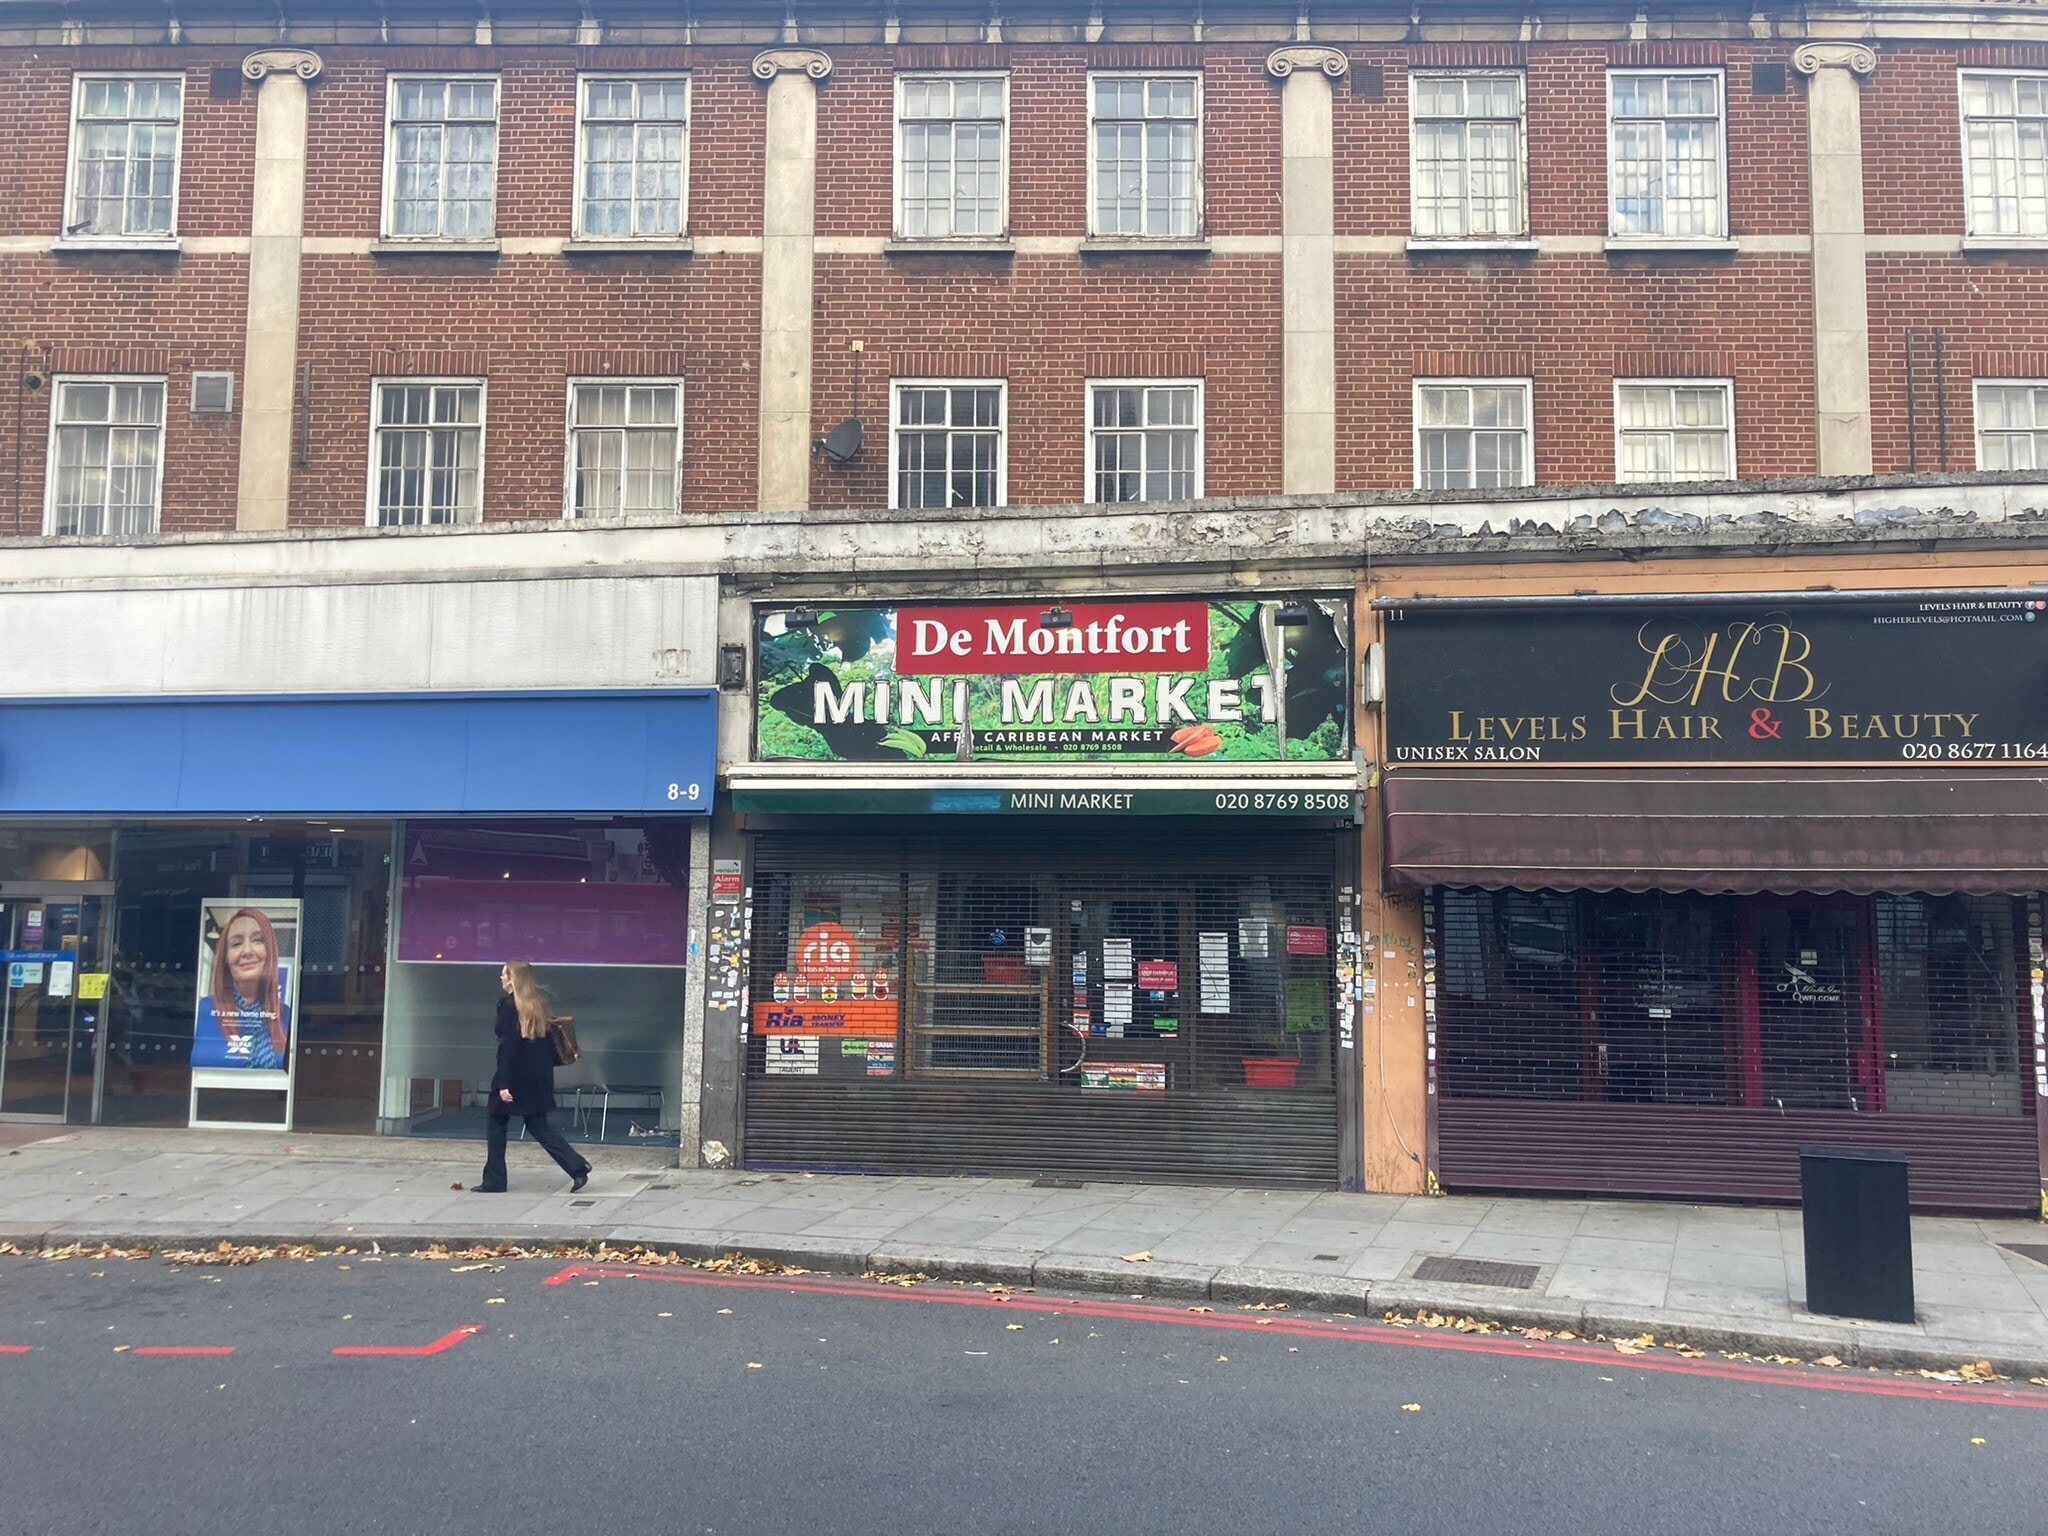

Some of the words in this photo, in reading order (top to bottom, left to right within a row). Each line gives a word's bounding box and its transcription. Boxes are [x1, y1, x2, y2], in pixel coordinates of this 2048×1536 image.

[1919, 603, 1950, 611] LEVELS
[1952, 602, 1977, 610] HAIR
[1986, 601, 2023, 609] BEAUTY
[1388, 609, 1405, 621] 11
[911, 619, 973, 656] De
[983, 614, 1191, 656] Montfort
[813, 677, 970, 725] MINI
[1001, 674, 1287, 725] MARKET
[1748, 706, 1782, 740] &
[931, 731, 975, 743] AFR
[984, 731, 1083, 743] CARIBBEAN
[1092, 731, 1164, 743] MARKET
[972, 743, 994, 752] etail
[995, 743, 1002, 751] &
[1004, 743, 1048, 751] Wholesale
[1063, 743, 1078, 751] 020
[1080, 743, 1100, 751] 8769
[1101, 743, 1123, 751] 8508
[1396, 747, 1469, 761] UNISEX
[1473, 747, 1541, 761] SALON
[1902, 742, 1942, 760] 020
[1948, 742, 1996, 760] 8677
[2001, 741, 2048, 760] 1164
[667, 783, 699, 801] 8-9
[1010, 794, 1055, 809] MINI
[1060, 794, 1134, 810] MARKET
[1215, 793, 1250, 809] 020
[1254, 794, 1299, 810] 8769
[1304, 794, 1350, 810] 8508
[715, 875, 740, 883] Alarm
[803, 931, 850, 963] ria
[211, 1009, 221, 1017] It's
[240, 1009, 259, 1018] home
[765, 1006, 804, 1028] Ria
